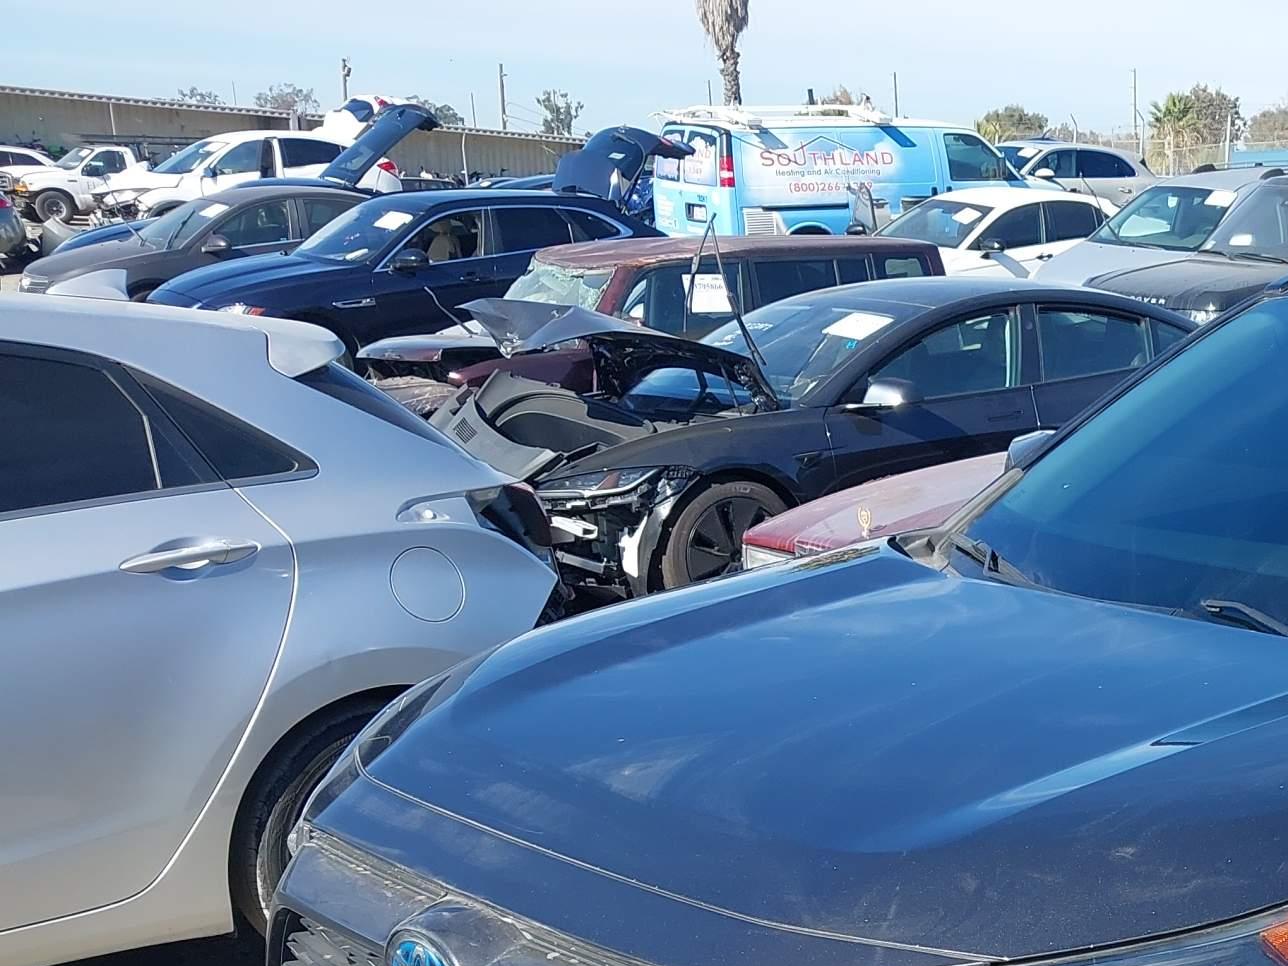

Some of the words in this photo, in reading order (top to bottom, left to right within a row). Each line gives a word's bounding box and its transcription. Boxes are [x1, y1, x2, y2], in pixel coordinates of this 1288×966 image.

[760, 141, 894, 167] SOUTHLAND
[775, 168, 806, 177] Heating
[835, 168, 882, 176] Conditioning
